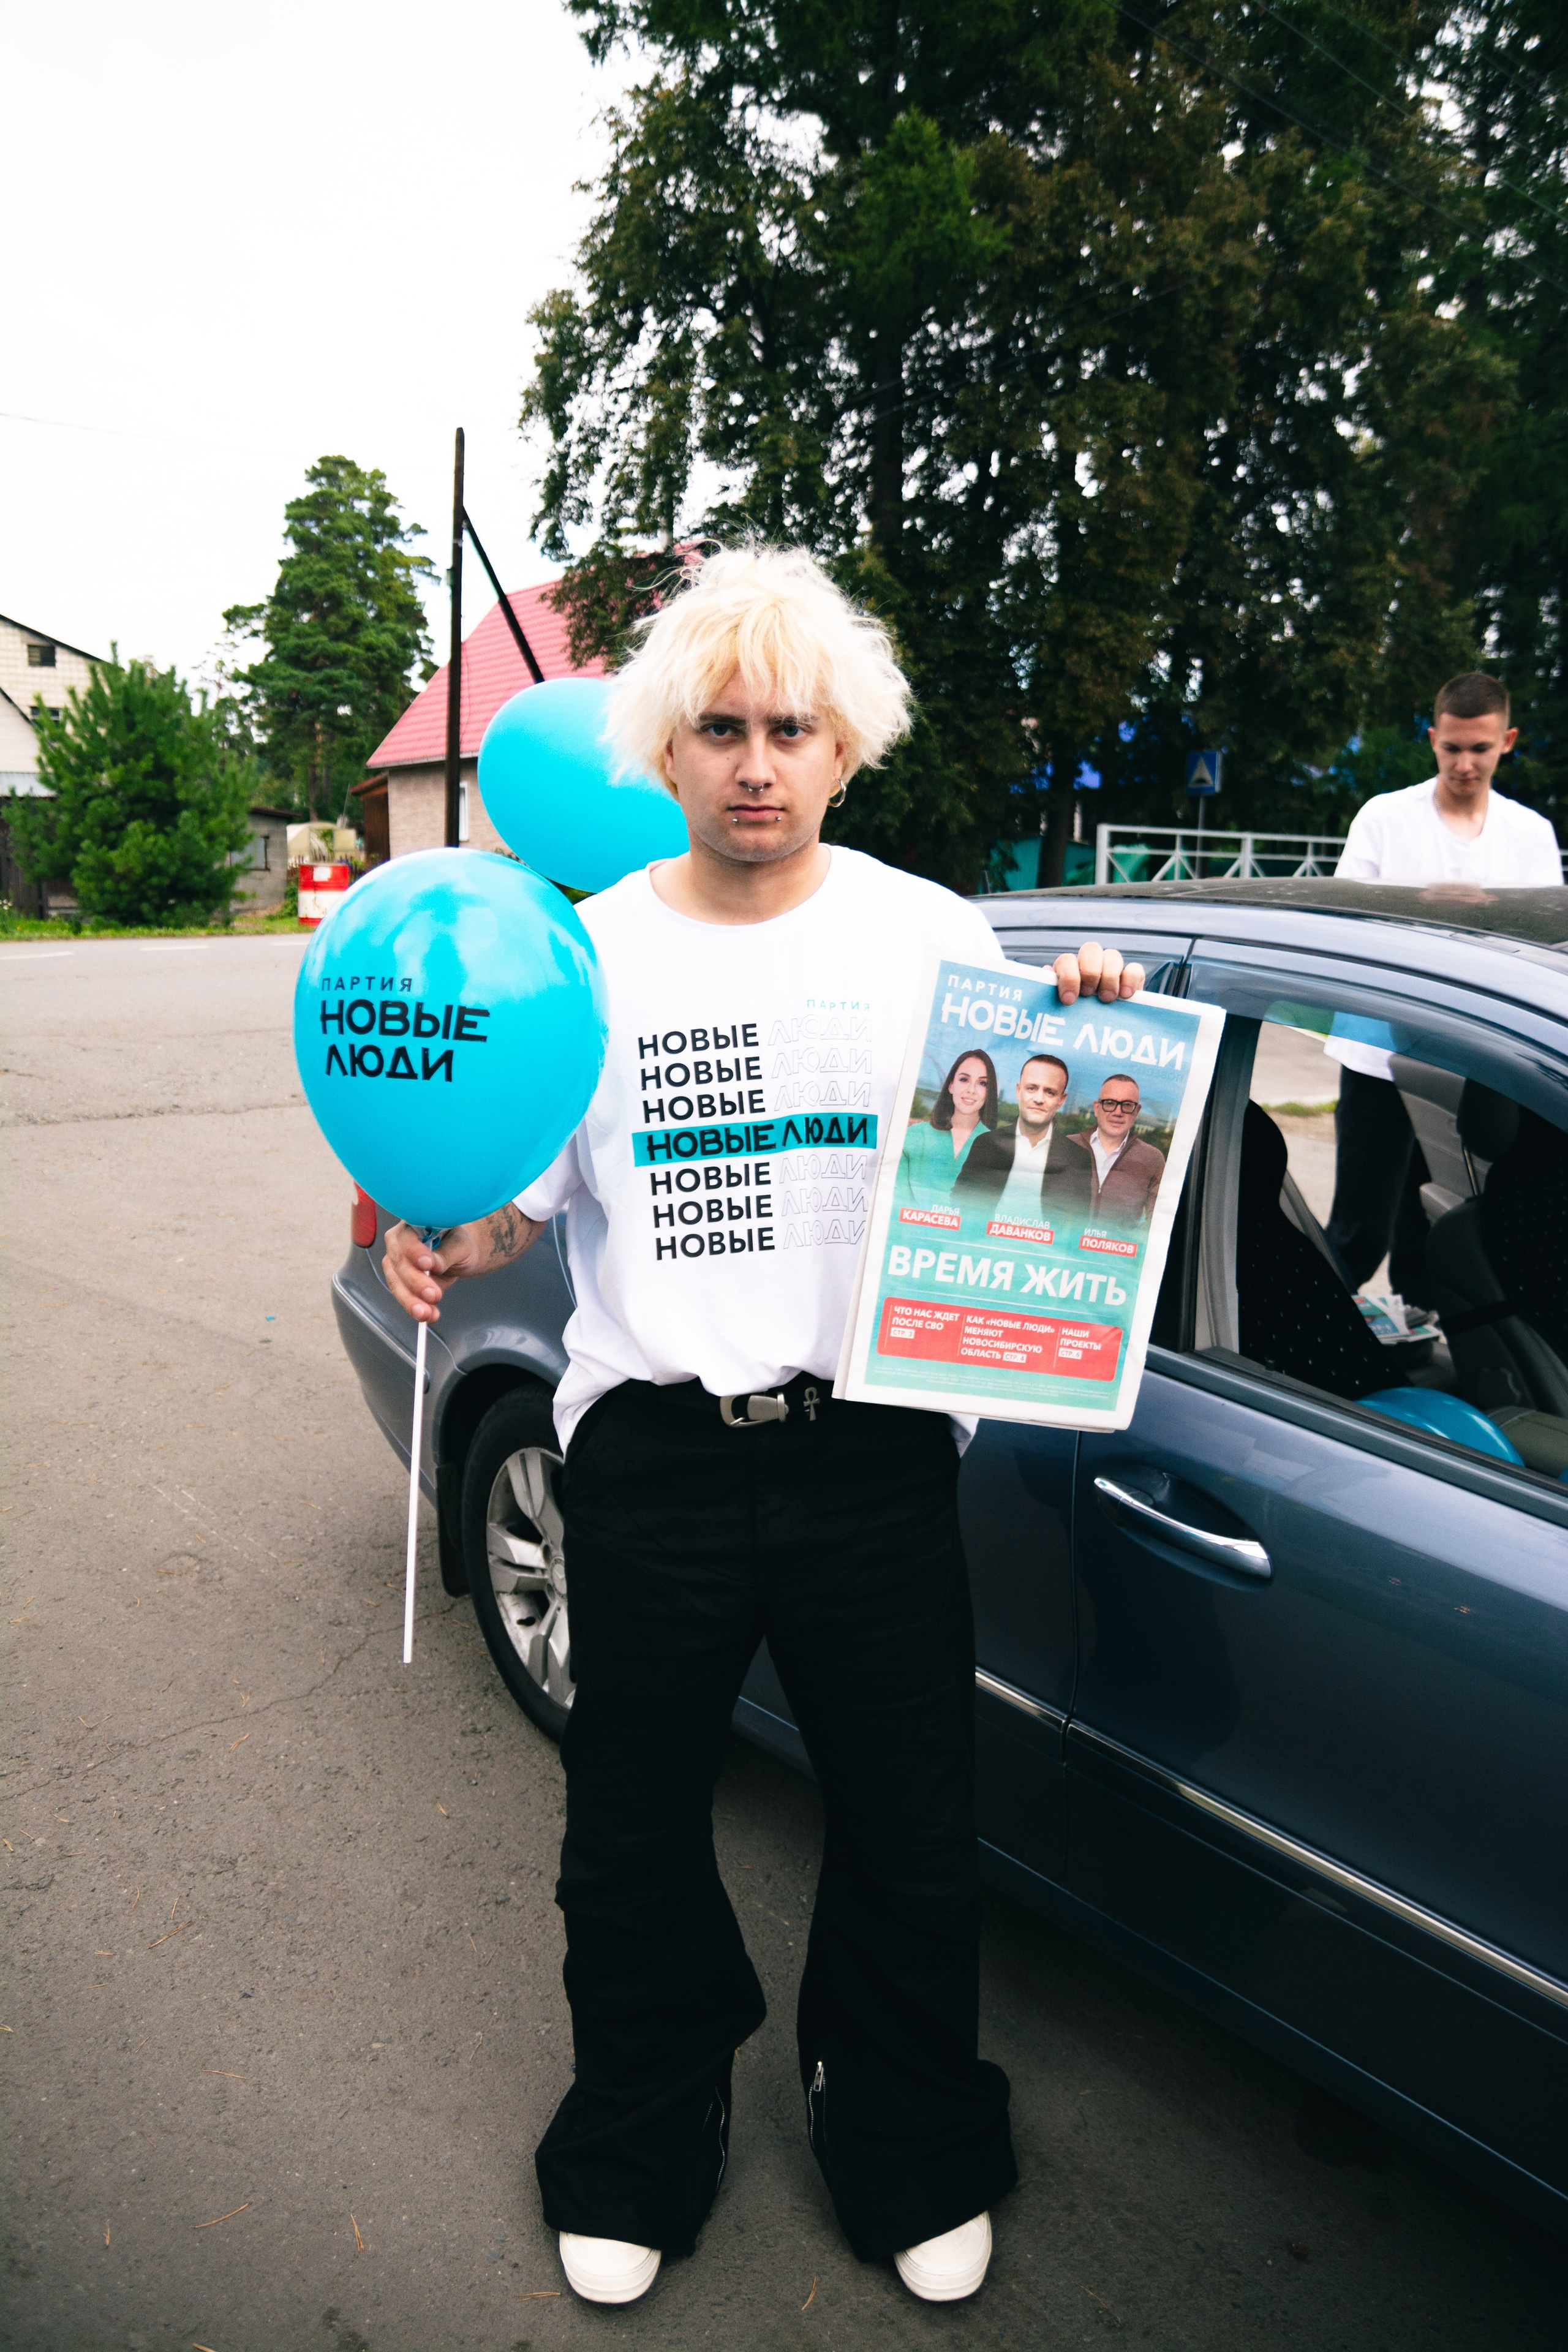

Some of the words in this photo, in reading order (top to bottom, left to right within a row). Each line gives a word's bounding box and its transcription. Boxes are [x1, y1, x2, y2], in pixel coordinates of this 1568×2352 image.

[322, 976, 412, 992] ПАРТИЯ
[947, 974, 1023, 1002] ПАРТИЯ
[806, 999, 870, 1012] ПАРТИЯ
[320, 998, 490, 1042] НОВЫЕ
[638, 1023, 760, 1059] НОВЫЕ
[767, 1014, 872, 1046] ЛЮДИ
[940, 992, 1066, 1046] НОВЫЕ
[1072, 1023, 1185, 1071] ЛЮДИ
[325, 1043, 454, 1082] ЛЮДИ
[641, 1056, 763, 1091] НОВЫЕ
[771, 1047, 872, 1079] ЛЮДИ
[643, 1089, 766, 1123] НОВЫЕ
[774, 1081, 871, 1112] ЛЮДИ
[647, 1123, 776, 1161] НОВЫЕ
[782, 1116, 868, 1147] ЛЮДИ
[650, 1162, 772, 1196] НОВЫЕ
[778, 1154, 868, 1184] ЛЮДИ
[653, 1194, 773, 1228] НОВЫЕ
[781, 1187, 869, 1217] ЛЮДИ
[930, 1204, 960, 1216] ДАРЬЯ
[902, 1210, 958, 1227] КАРАСЕВА
[994, 1213, 1050, 1229] ВЛАДИСЛАВ
[989, 1224, 1051, 1242] ДАВАНКОВ
[1084, 1228, 1107, 1238] ИЛЬЯ
[655, 1227, 775, 1261] НОВЫЕ
[1082, 1238, 1134, 1254] ПОЛЯКОВ
[888, 1245, 1014, 1291] ВРЕМЯ
[1020, 1264, 1126, 1306] ЖИТЬ
[894, 1306, 912, 1316] ЧТО
[913, 1309, 933, 1317] НАС
[933, 1311, 960, 1322] ЖДЕТ
[892, 1317, 924, 1328] ПОСЛЕ
[925, 1321, 944, 1330] СВО
[964, 1326, 1004, 1338] МЕНЯЮТ
[966, 1315, 984, 1325] КАК
[985, 1318, 1021, 1330] «НОВЫЕ
[1022, 1322, 1055, 1333] ЛЮДИ»
[1061, 1327, 1090, 1338] НАШИ
[960, 1347, 1001, 1359] ОБЛАСТЬ
[962, 1336, 1042, 1354] НОВОСИБИРСКУЮ
[1060, 1338, 1101, 1351] ПРОЕКТЫ
